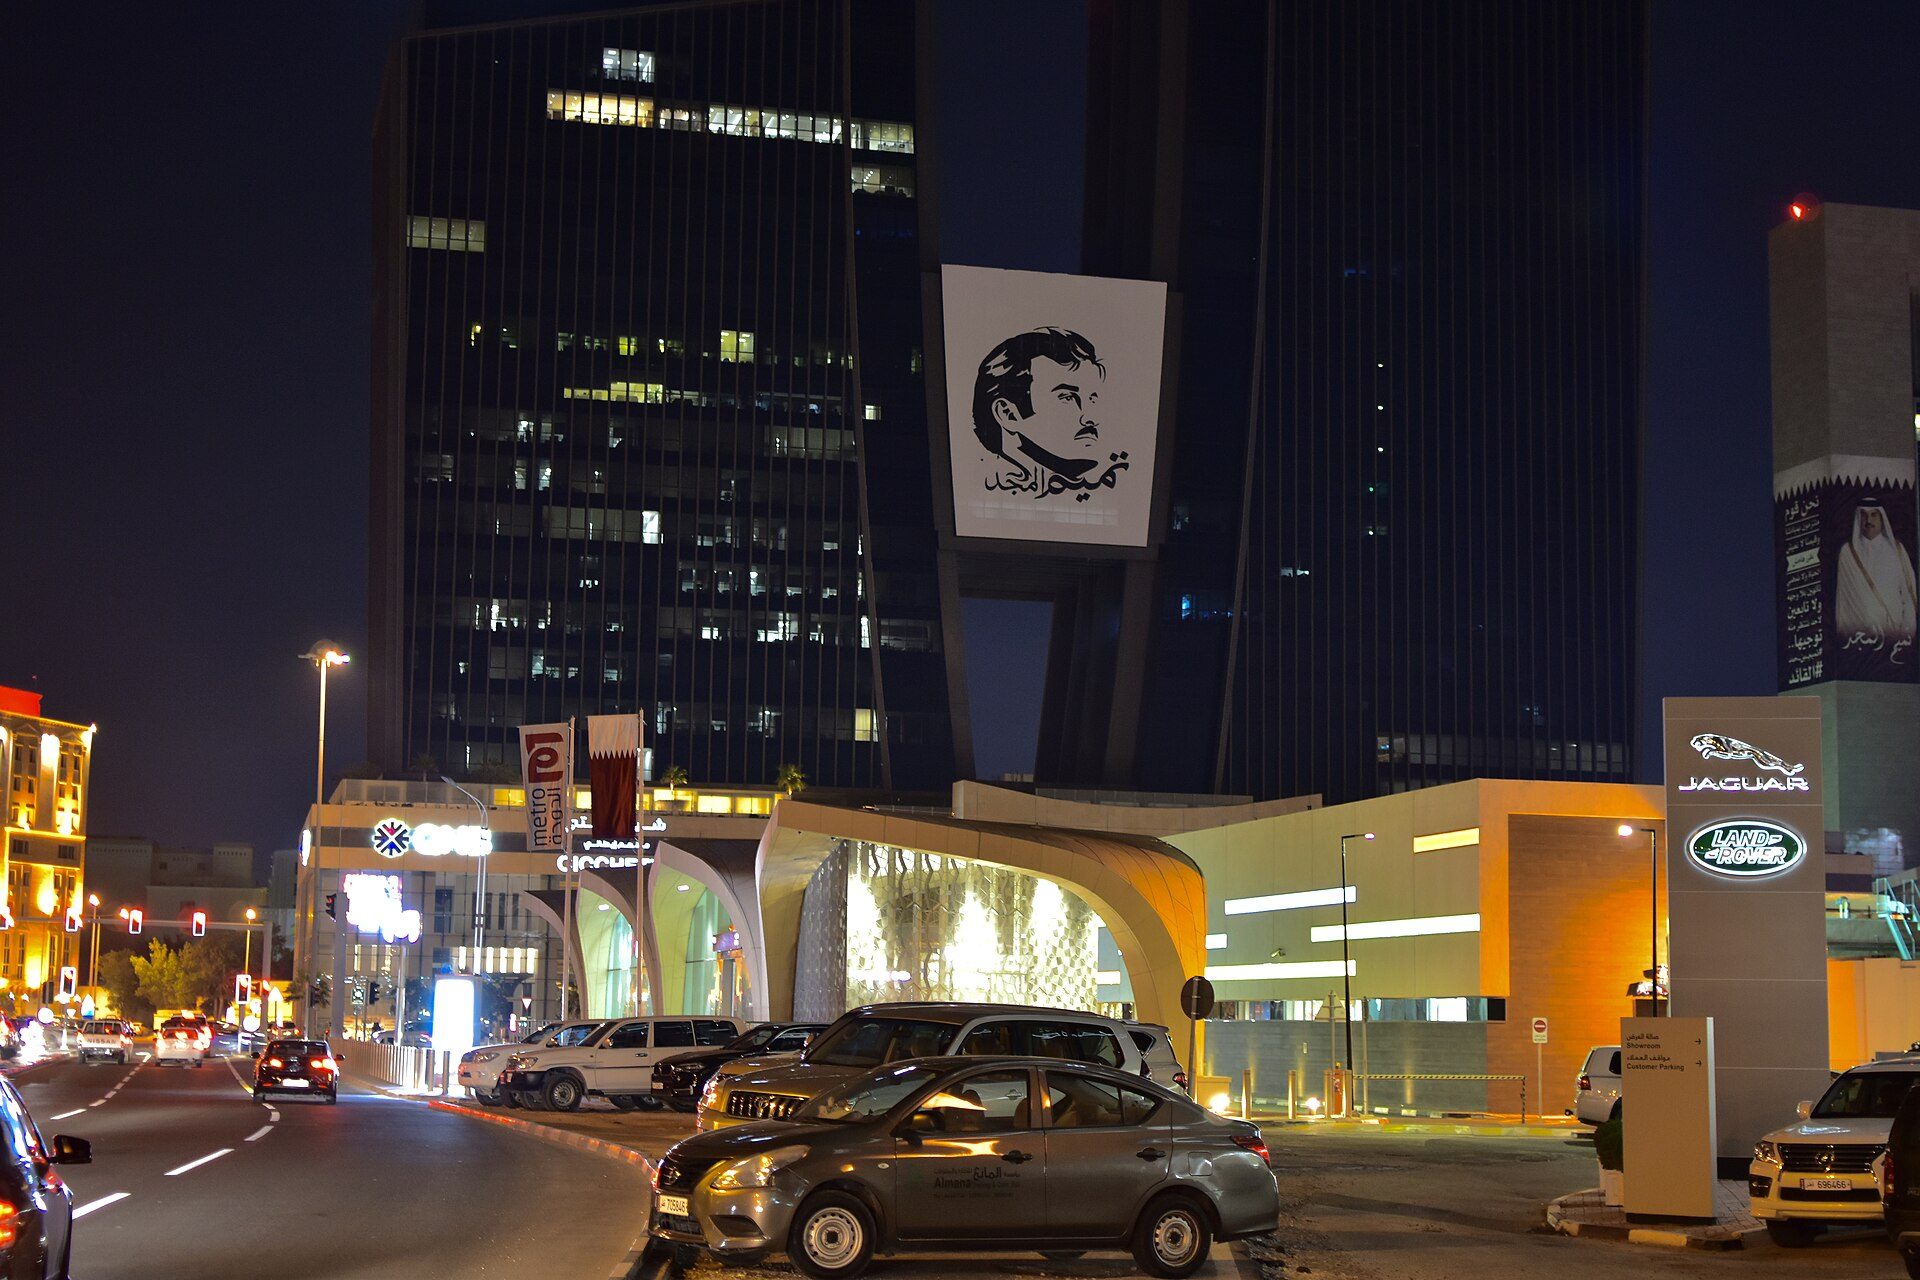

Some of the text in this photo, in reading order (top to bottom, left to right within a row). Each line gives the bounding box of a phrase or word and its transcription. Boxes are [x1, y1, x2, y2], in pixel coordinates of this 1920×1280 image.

[984, 451, 1130, 503] تميم المجد
[1678, 776, 1810, 792] JAGUAR
[530, 787, 548, 847] metro
[547, 787, 564, 847] الدوحة
[1712, 830, 1769, 847] LAND
[1715, 847, 1788, 865] ROVER
[1659, 1063, 1685, 1071] Parking
[934, 1176, 972, 1189] Almana
